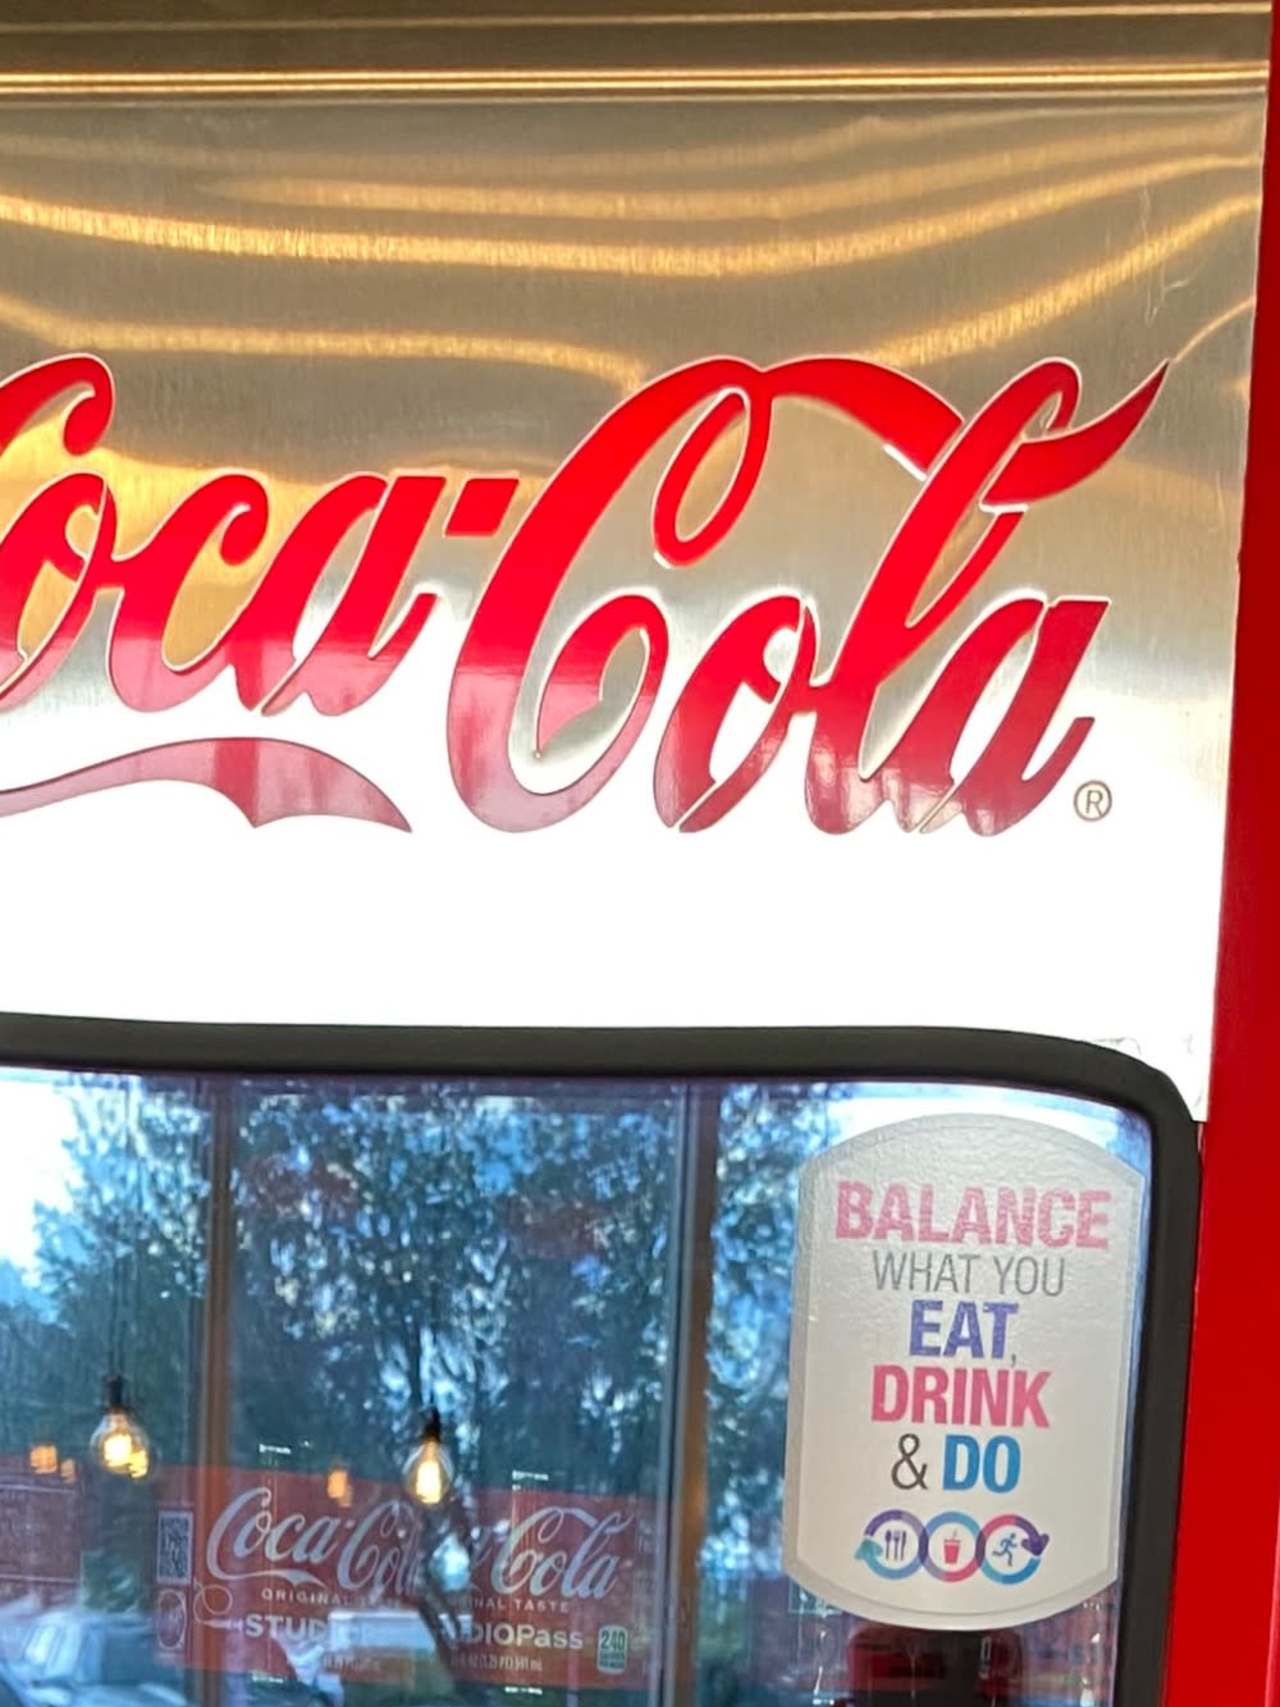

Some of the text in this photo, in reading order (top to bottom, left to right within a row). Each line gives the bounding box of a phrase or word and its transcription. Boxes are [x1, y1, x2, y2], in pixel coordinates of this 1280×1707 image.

[835, 1180, 1112, 1250] BALANCE
[872, 1249, 1067, 1298] WHAT YOU
[908, 1300, 1019, 1368] EAT,
[870, 1364, 1053, 1429] DRINK
[890, 1433, 1022, 1494] & DO
